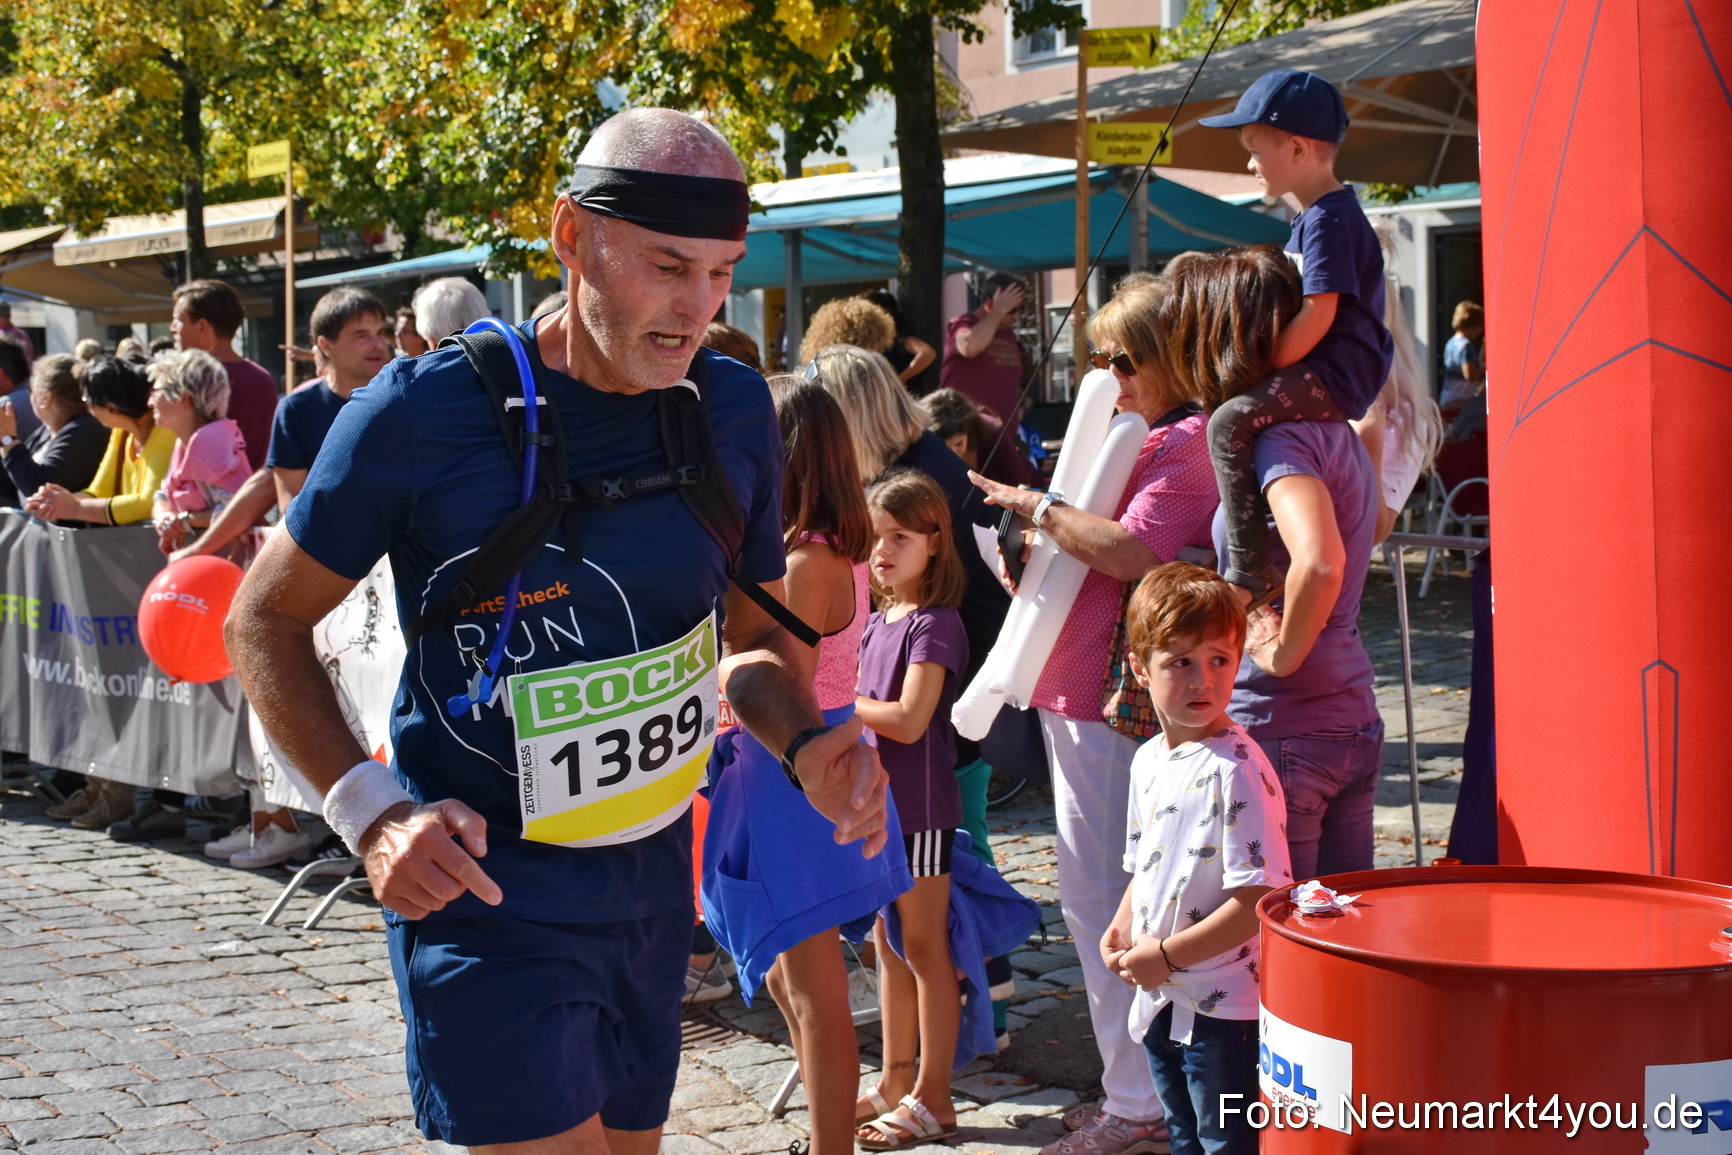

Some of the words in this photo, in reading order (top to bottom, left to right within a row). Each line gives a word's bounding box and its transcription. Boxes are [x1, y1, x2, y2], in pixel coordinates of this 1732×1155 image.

[1096, 130, 1154, 143] Kleiderbeutel-
[1107, 145, 1142, 158] ausgabe
[531, 633, 705, 726] BOCK
[550, 695, 703, 796] 1389
